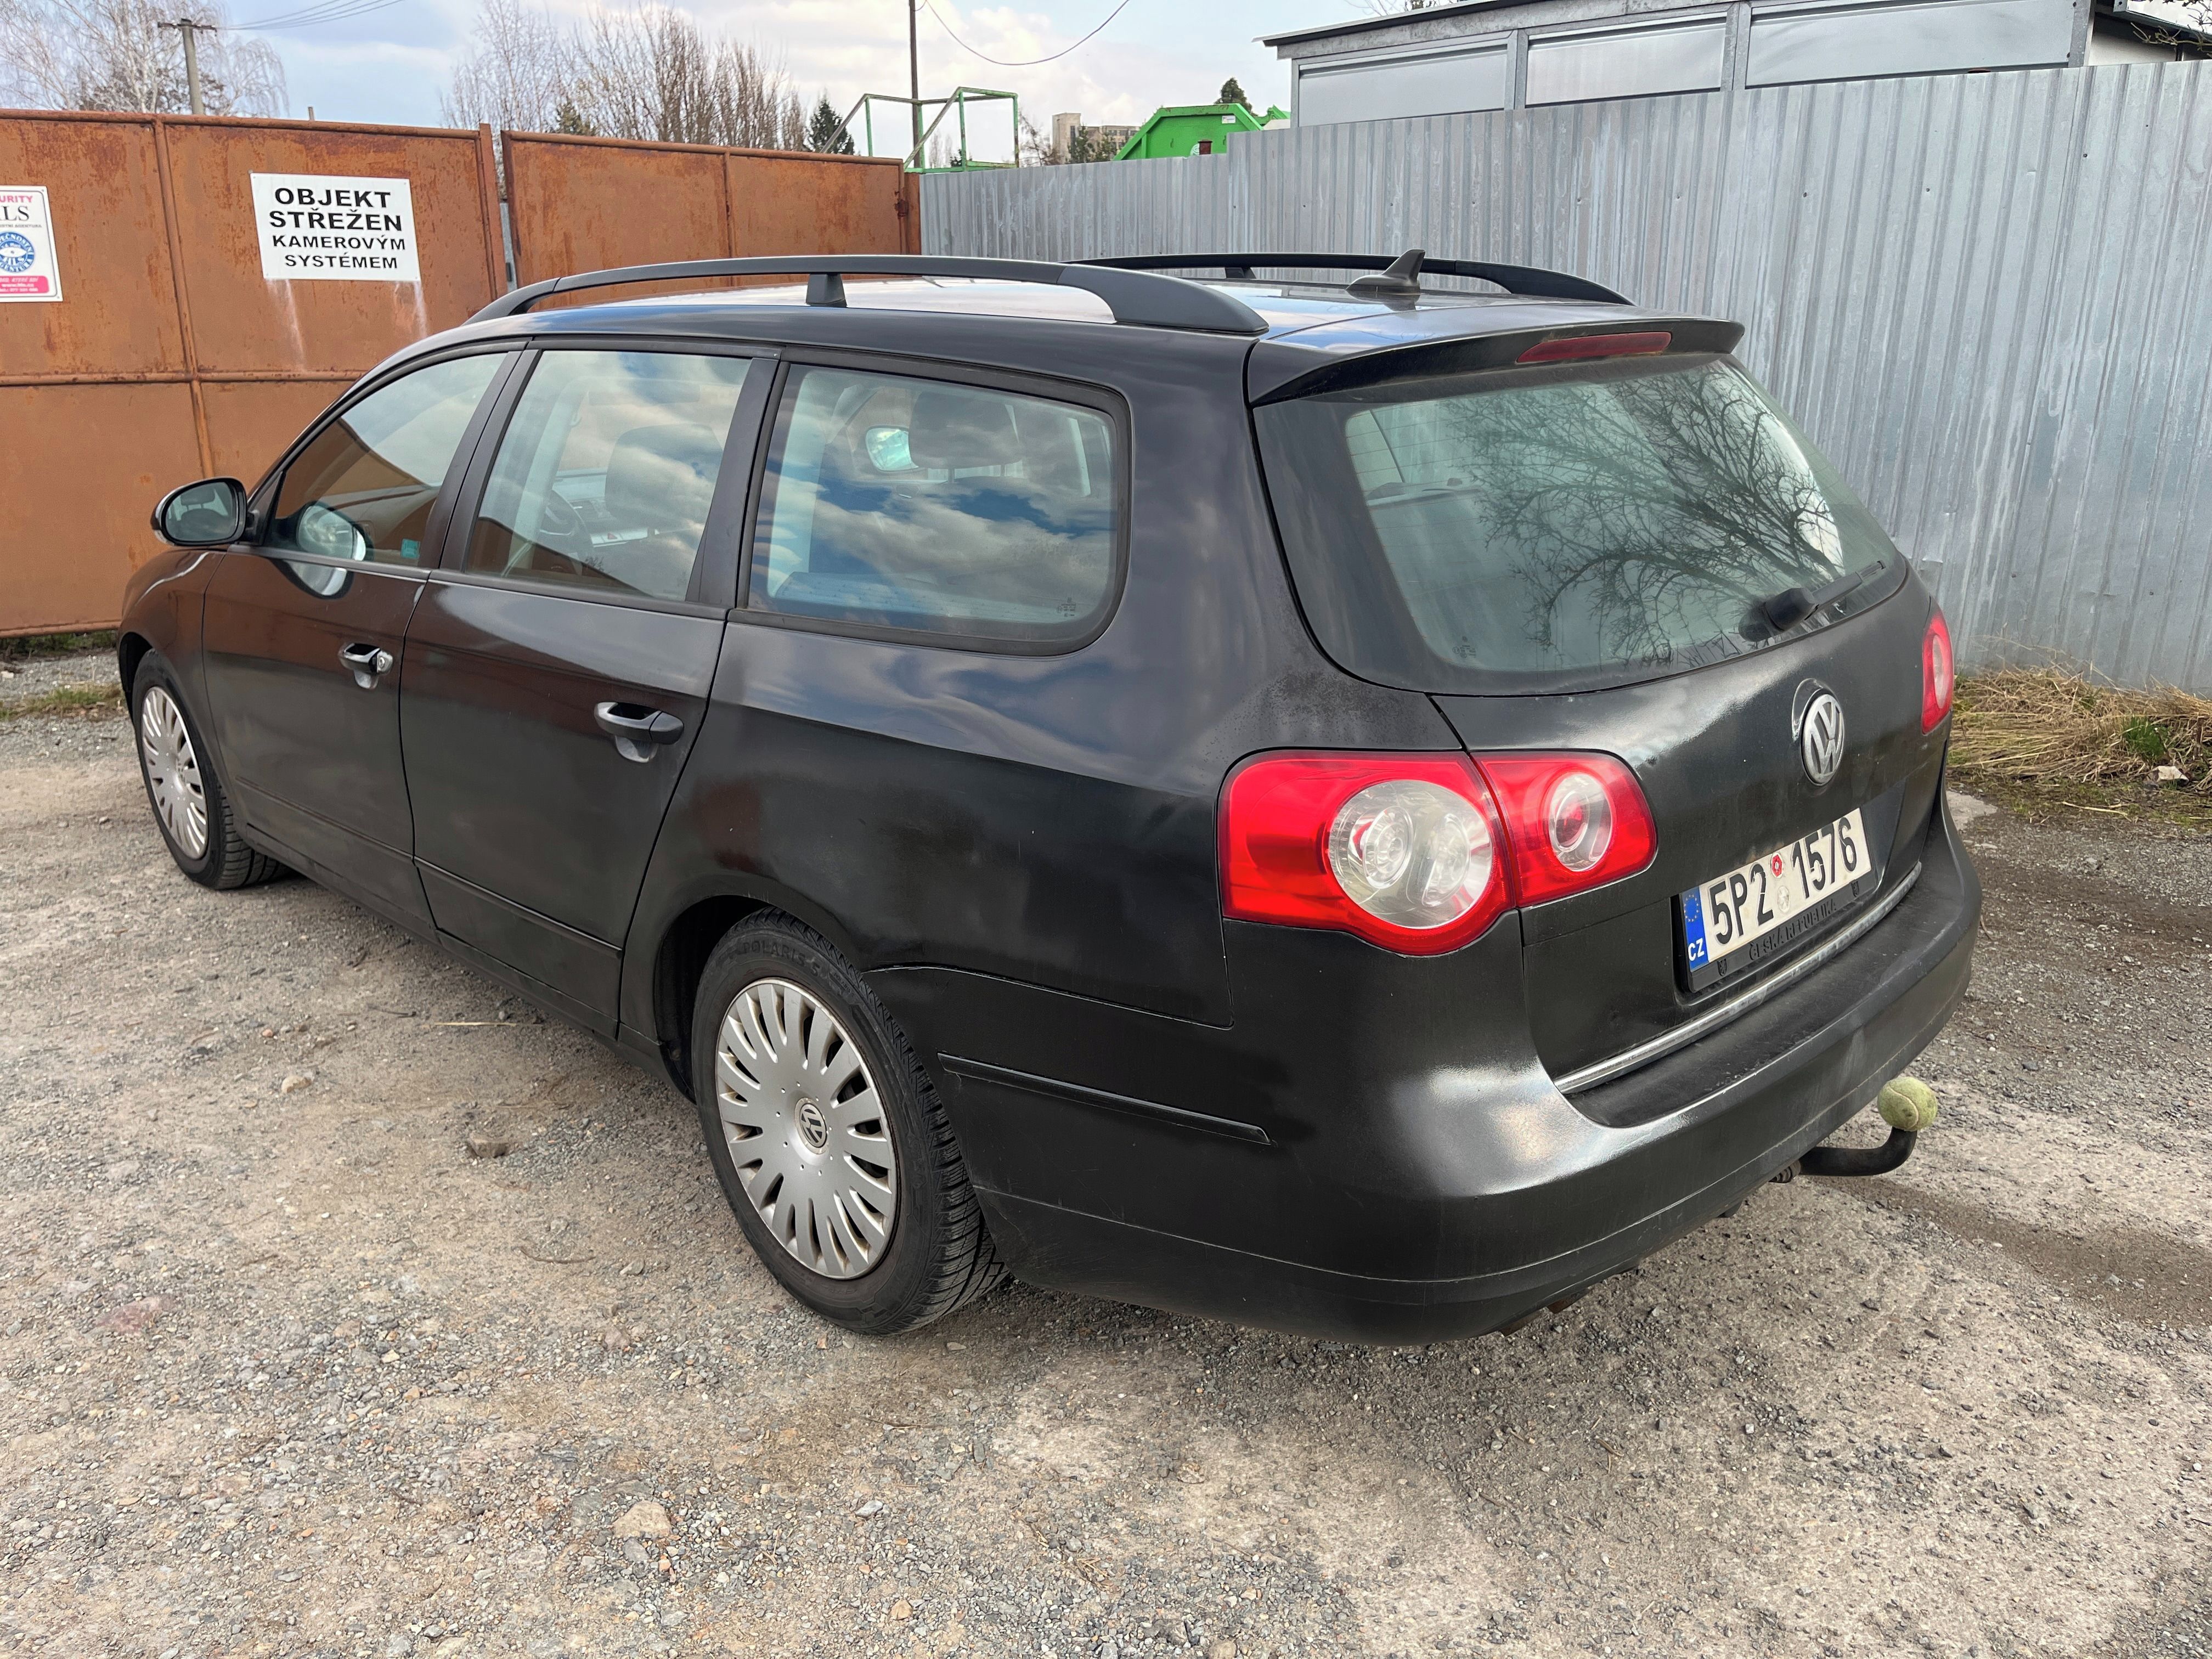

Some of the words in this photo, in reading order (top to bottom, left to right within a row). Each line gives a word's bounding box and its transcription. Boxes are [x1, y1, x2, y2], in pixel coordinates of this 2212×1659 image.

[275, 188, 391, 208] OBJEKT
[269, 208, 402, 231] STŘEŽEN
[273, 235, 405, 250] KAMEROVÝM
[285, 252, 397, 269] SYSTÉMEM
[1709, 862, 1774, 945] 5P2
[1791, 816, 1858, 899] 1576
[743, 940, 805, 967] POLARIS
[1688, 937, 1705, 961] CZ
